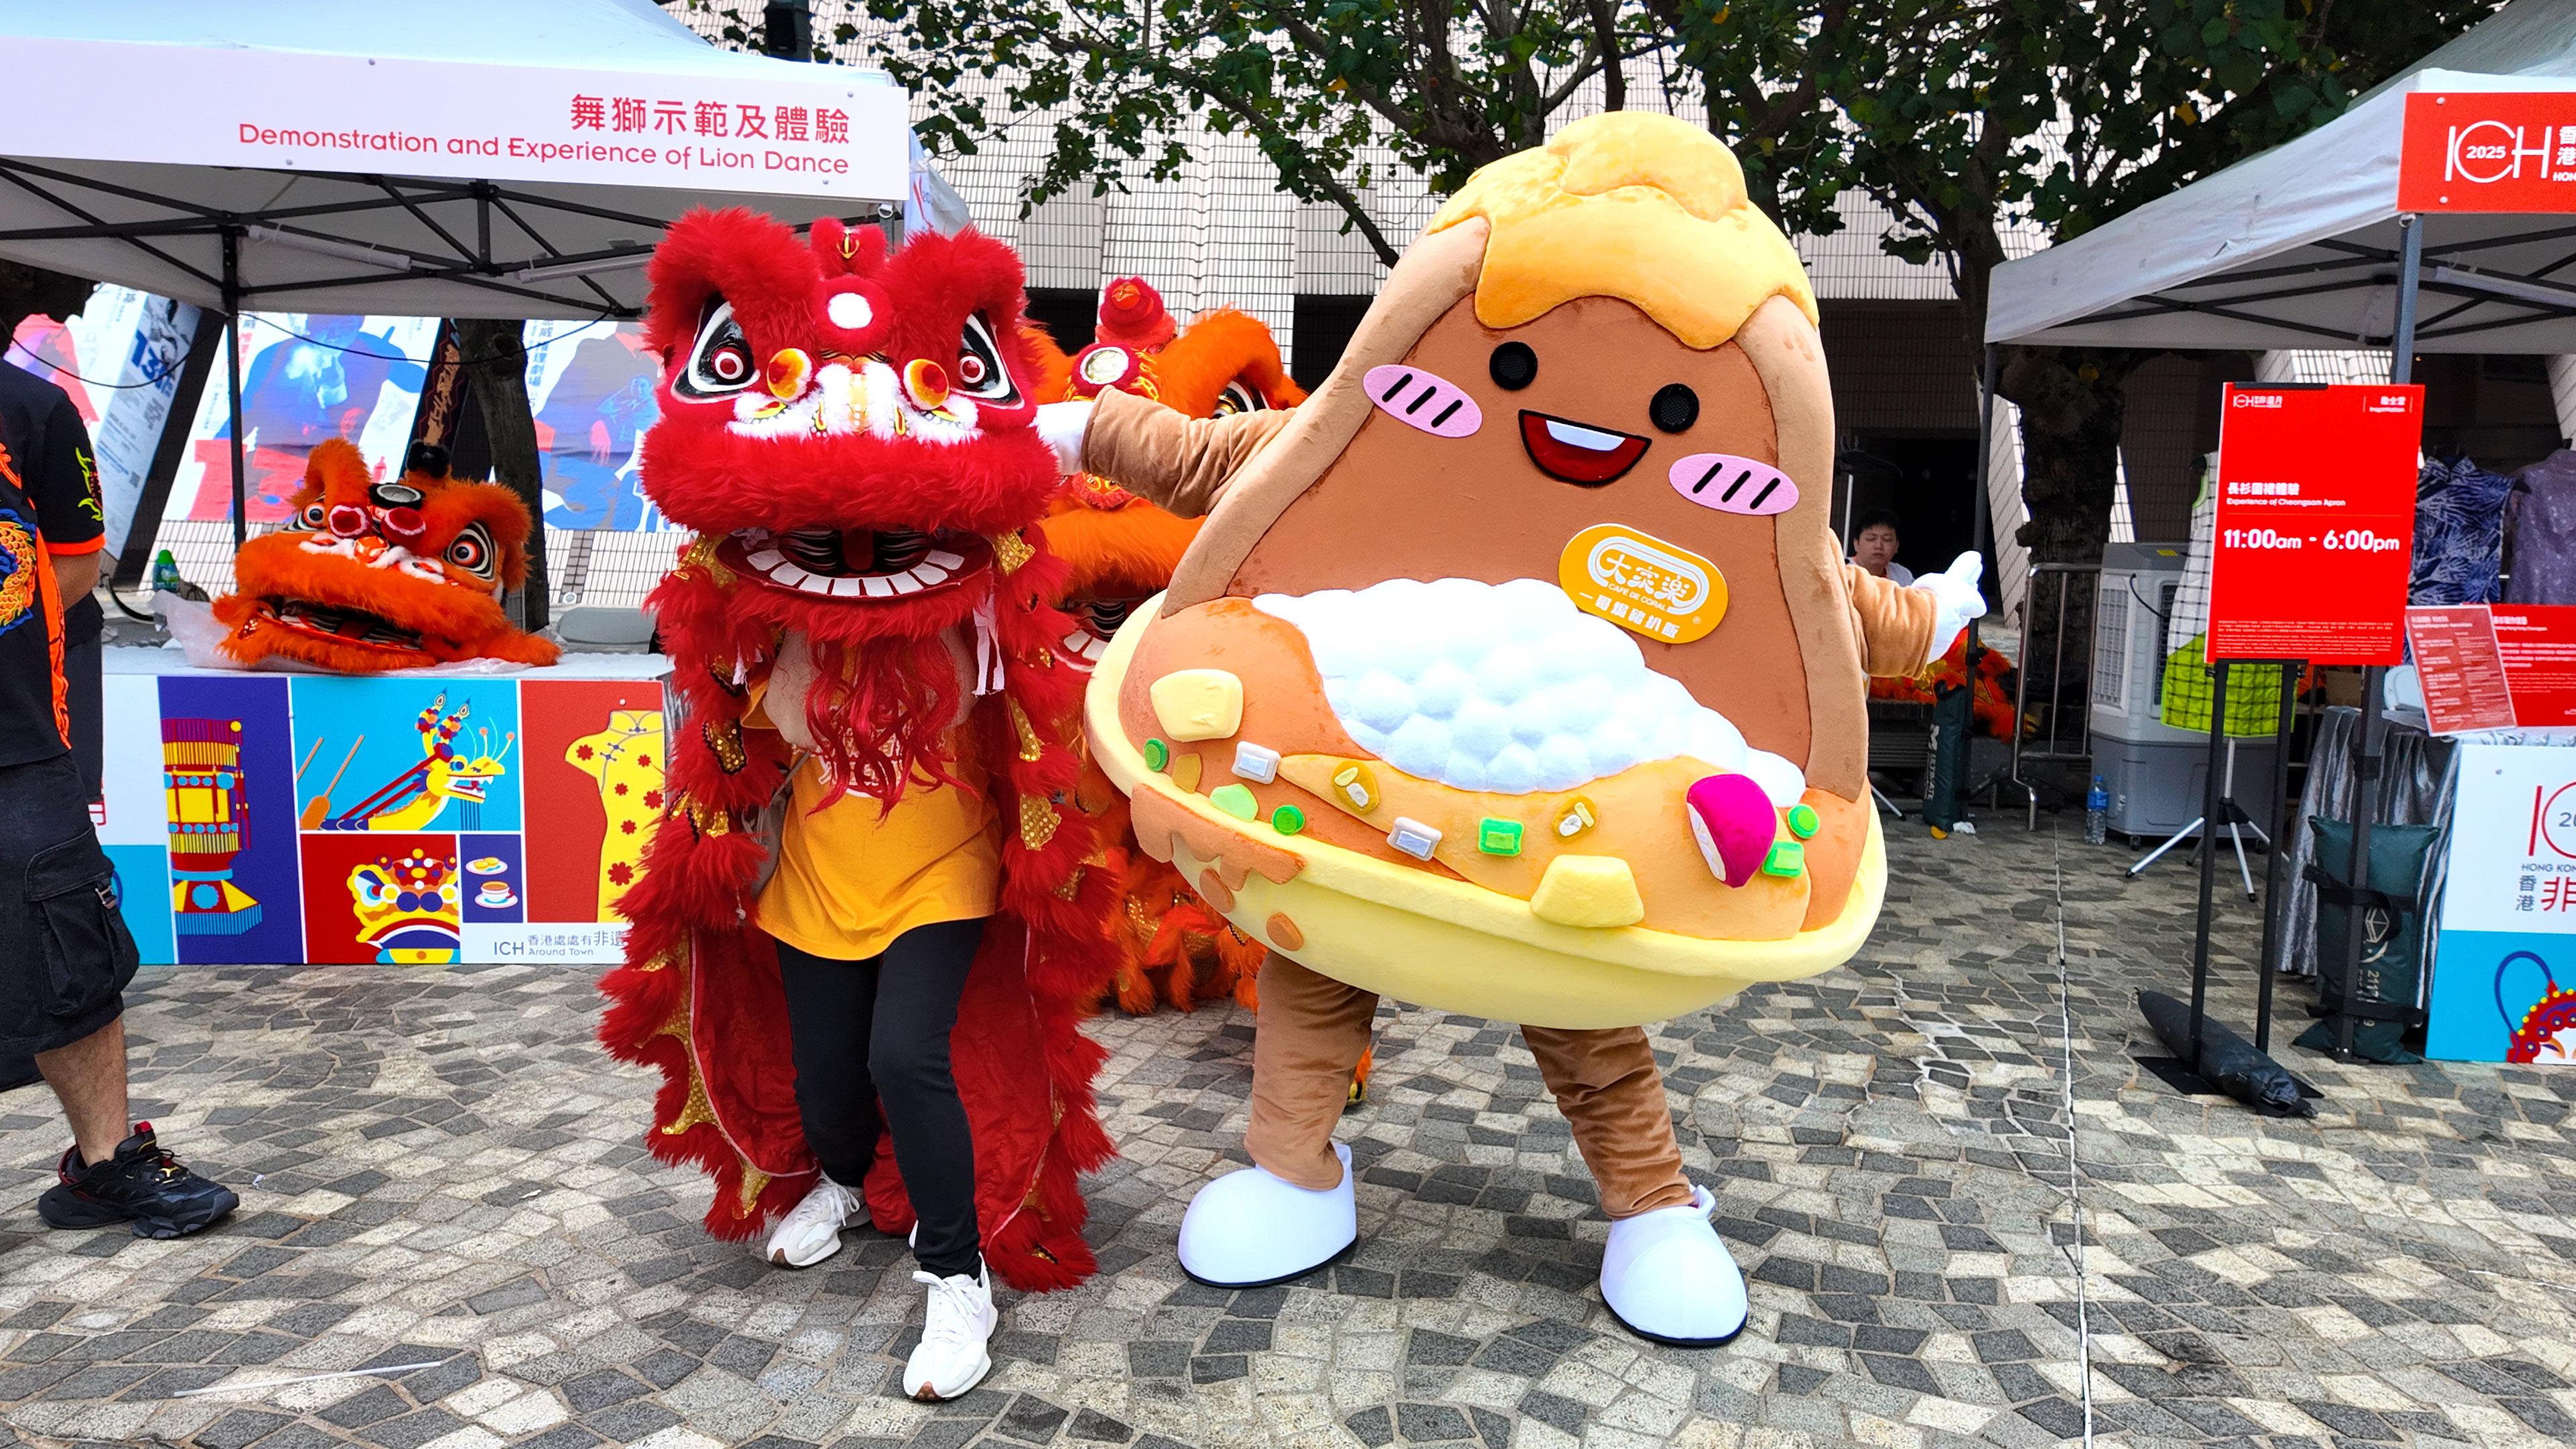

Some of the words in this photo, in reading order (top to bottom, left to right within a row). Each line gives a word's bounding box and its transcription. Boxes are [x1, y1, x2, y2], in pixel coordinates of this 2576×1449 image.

[571, 94, 849, 144] 舞獅示範及體驗
[239, 123, 437, 152] Demonstration
[447, 137, 498, 156] and
[508, 138, 657, 164] Experience
[665, 146, 692, 170] of
[700, 147, 754, 169] Lion
[765, 151, 849, 174] Dance
[2445, 120, 2552, 183] ICH
[2466, 146, 2506, 159] 2025
[2224, 529, 2302, 549] 11:00am
[2323, 530, 2400, 553] 6:00pm
[1629, 591, 1641, 600] DE
[1640, 596, 1666, 612] CORAL
[2522, 863, 2553, 872] HONG
[494, 941, 525, 956] ICH
[529, 948, 566, 956] Around
[570, 948, 594, 956] Town
